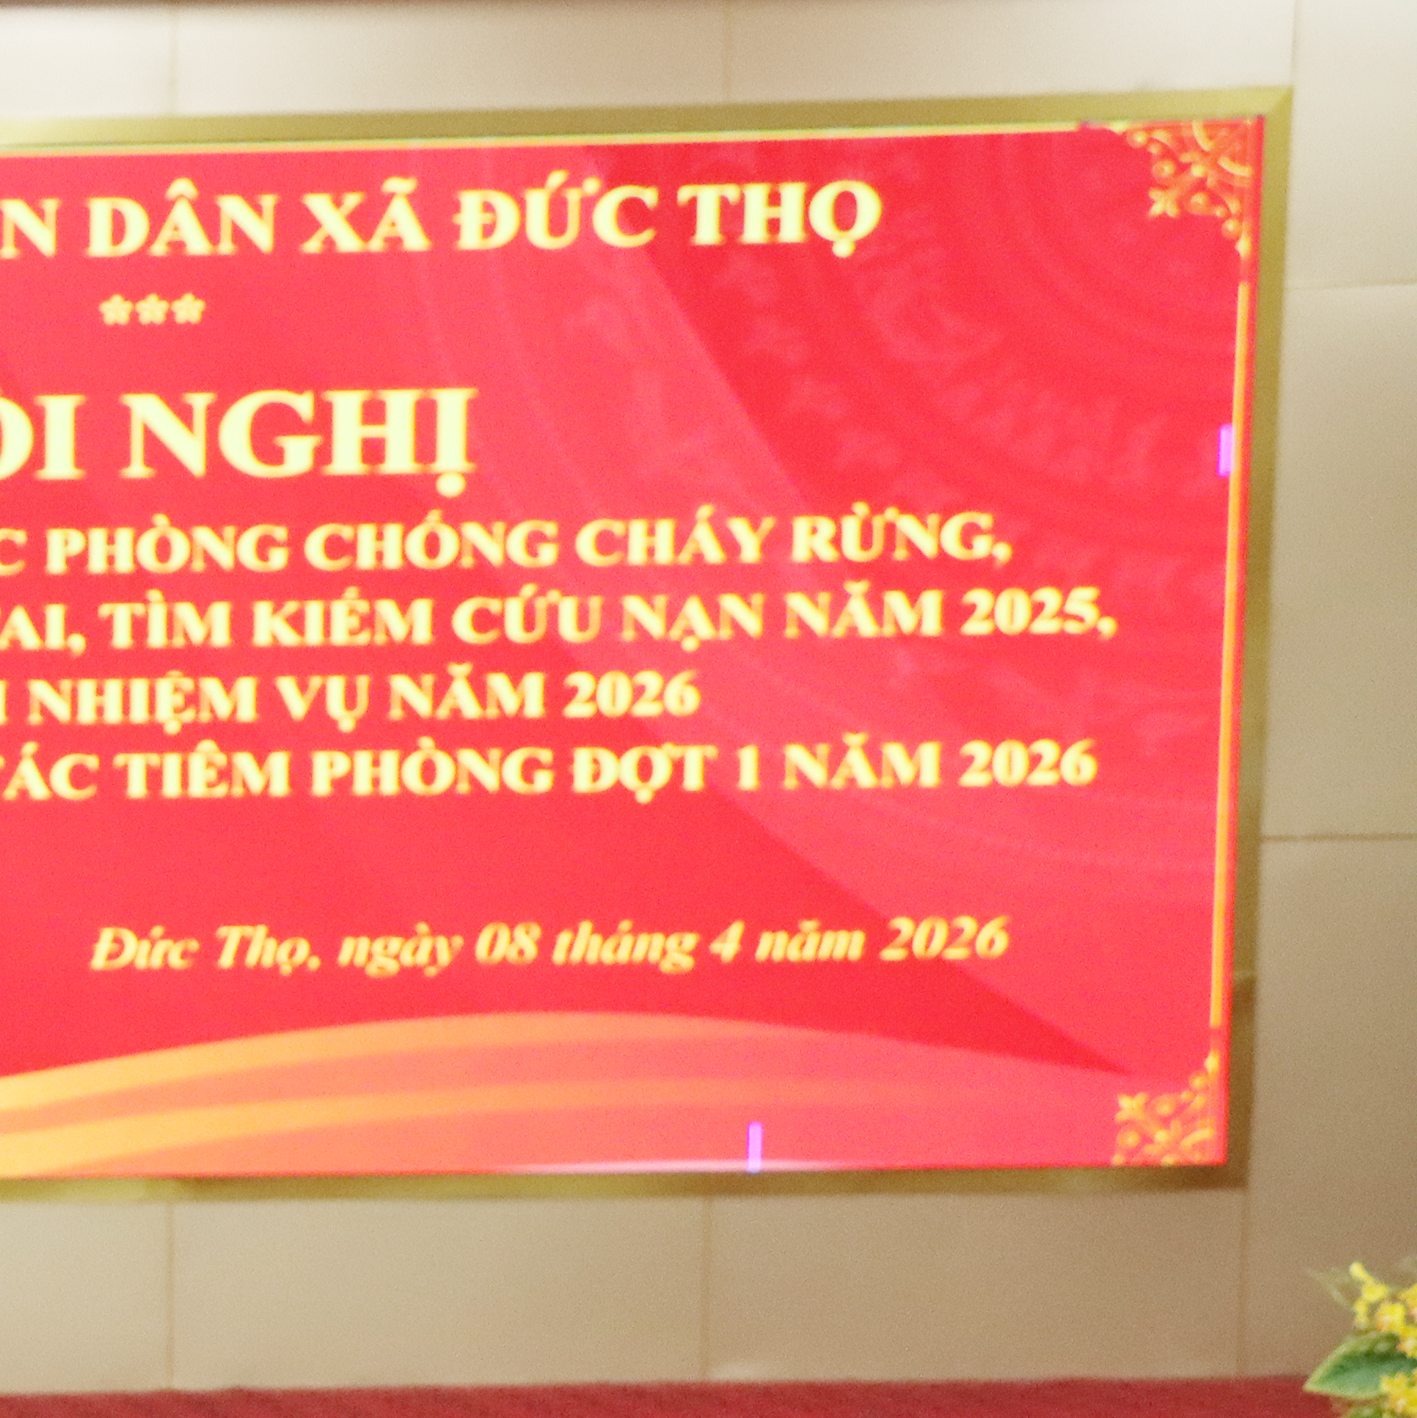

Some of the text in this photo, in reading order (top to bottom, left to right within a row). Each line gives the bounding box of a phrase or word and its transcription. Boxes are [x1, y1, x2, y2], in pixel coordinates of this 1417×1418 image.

[85, 177, 278, 258] DÂN
[301, 176, 432, 254] XÃ
[452, 169, 658, 251] ĐỨC
[677, 179, 882, 258] THỌ
[120, 387, 478, 498] NGHỊ
[46, 513, 290, 575] PHÒNG
[304, 509, 560, 571] CHỐNG
[574, 503, 776, 567] CHÁY
[789, 501, 1012, 568] RỪNG,
[98, 589, 232, 649] TÌM
[252, 586, 434, 647] KIẾM
[452, 583, 604, 644] CỨU
[620, 592, 765, 653] NẠN
[784, 580, 944, 639] NĂM
[27, 670, 258, 735] NHIỆM
[275, 675, 371, 733] VỤ
[389, 662, 546, 720] NĂM
[563, 669, 702, 718] 2026
[113, 739, 291, 799] TIÊM
[311, 736, 554, 797] PHÒNG
[571, 742, 719, 804] ĐỢT
[736, 744, 760, 791] 1
[782, 731, 942, 790] NĂM
[958, 739, 1098, 788] 2026
[90, 926, 200, 970] Đức
[338, 922, 464, 977] ngày
[475, 923, 542, 963] 08
[552, 920, 699, 973] tháng
[710, 921, 744, 962] 4
[756, 920, 865, 962] năm
[881, 915, 1009, 961] 2026
